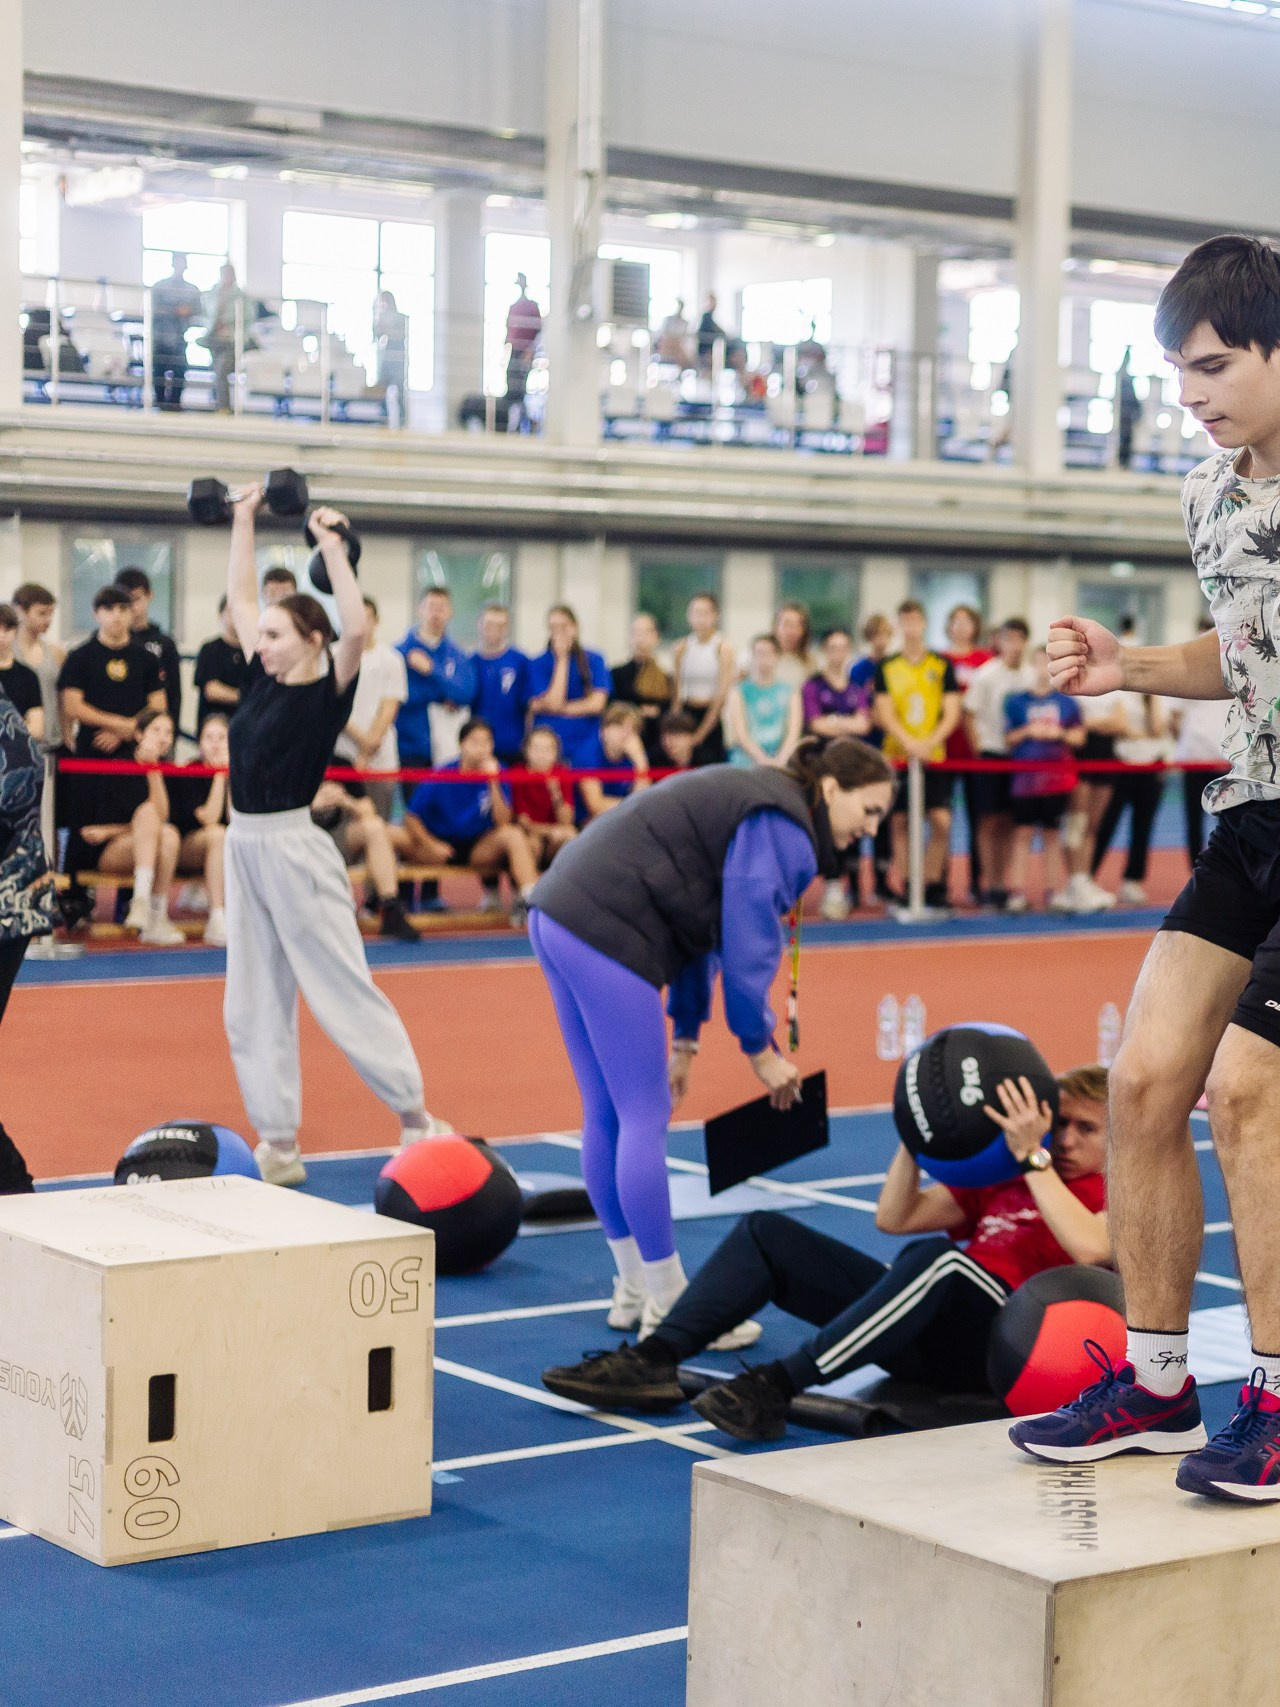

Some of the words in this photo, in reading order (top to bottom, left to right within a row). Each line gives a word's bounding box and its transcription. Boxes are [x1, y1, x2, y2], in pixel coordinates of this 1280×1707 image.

[348, 1256, 423, 1318] 50
[68, 1454, 95, 1539] 75
[124, 1455, 181, 1540] 60
